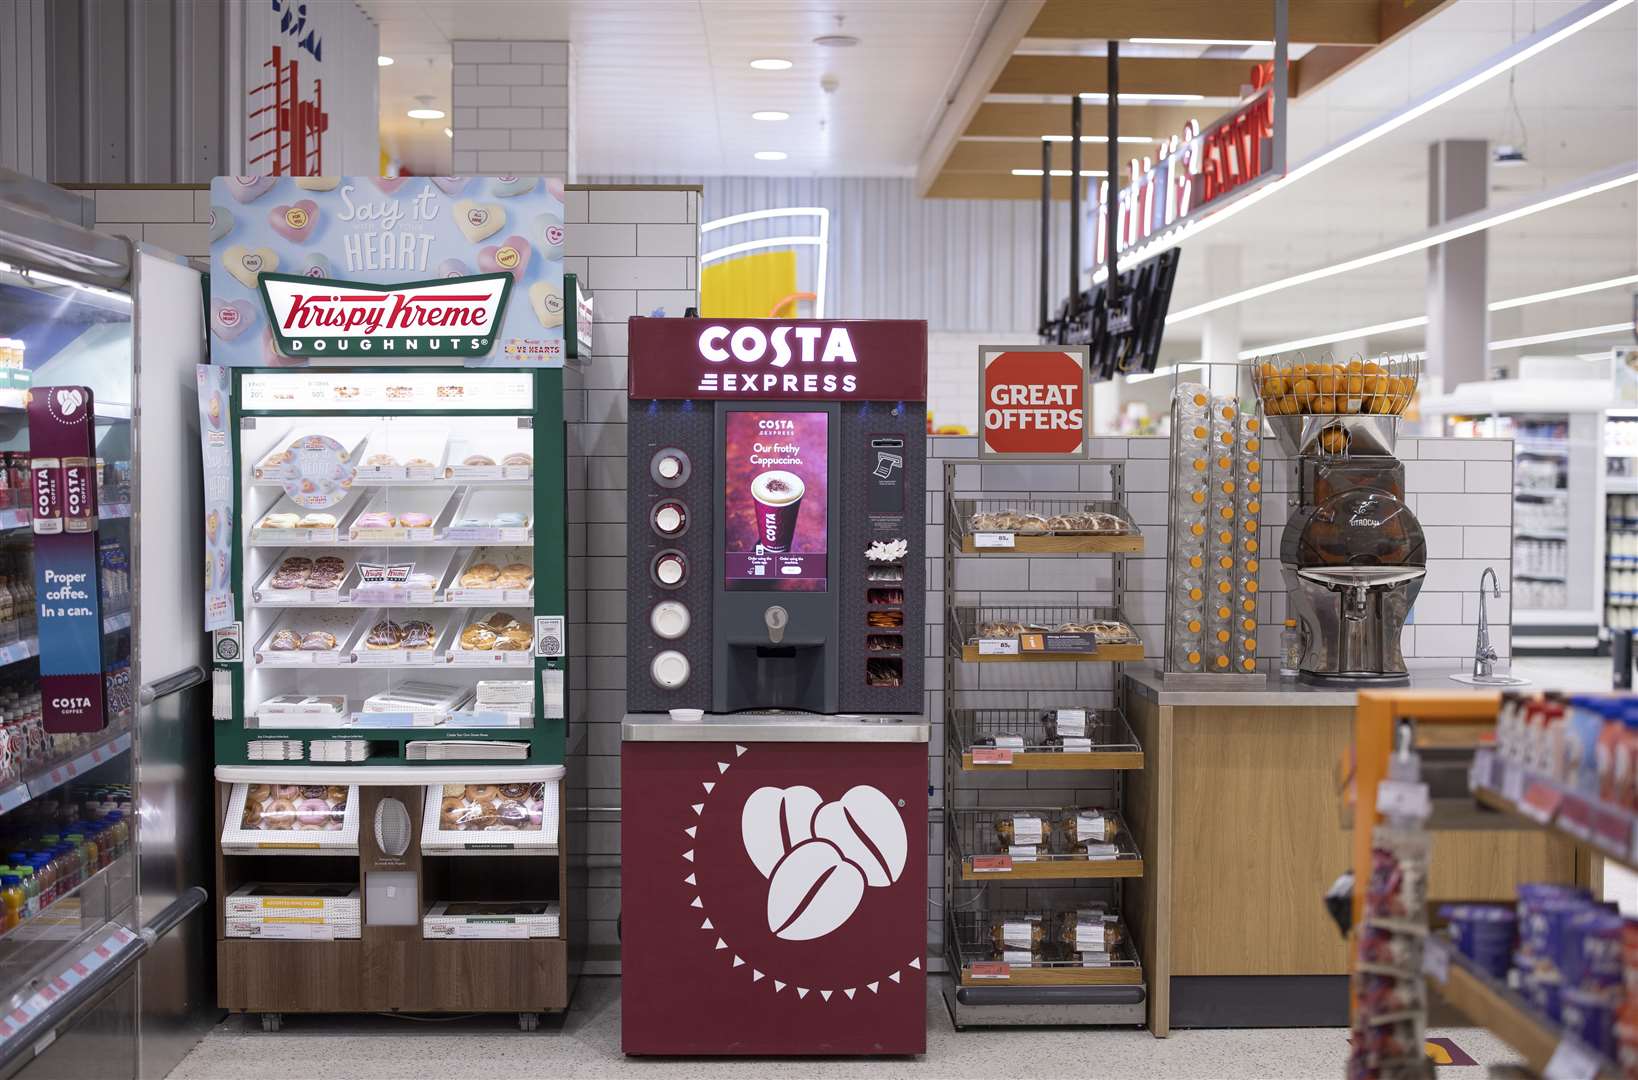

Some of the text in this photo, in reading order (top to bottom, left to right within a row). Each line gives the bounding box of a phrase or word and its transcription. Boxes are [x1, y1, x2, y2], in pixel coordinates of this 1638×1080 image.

[337, 184, 440, 231] Say it
[343, 231, 435, 272] HEART
[284, 293, 492, 335] Krispy Kreme
[528, 346, 560, 354] HEARTS
[698, 326, 857, 368] COSTA
[722, 373, 857, 392] EXPRESS
[990, 384, 1078, 406] GREAT
[758, 419, 794, 430] COSTA
[984, 408, 1083, 430] OFFERS
[753, 442, 800, 456] Our frothy
[750, 454, 803, 468] Cappuccino.
[38, 469, 50, 516] COSTA
[68, 468, 80, 515] COSTA
[765, 513, 777, 542] COSTA
[45, 570, 86, 586] Proper
[46, 586, 89, 600] coffee.
[41, 603, 93, 617] In a can.
[52, 697, 92, 709] COSTA
